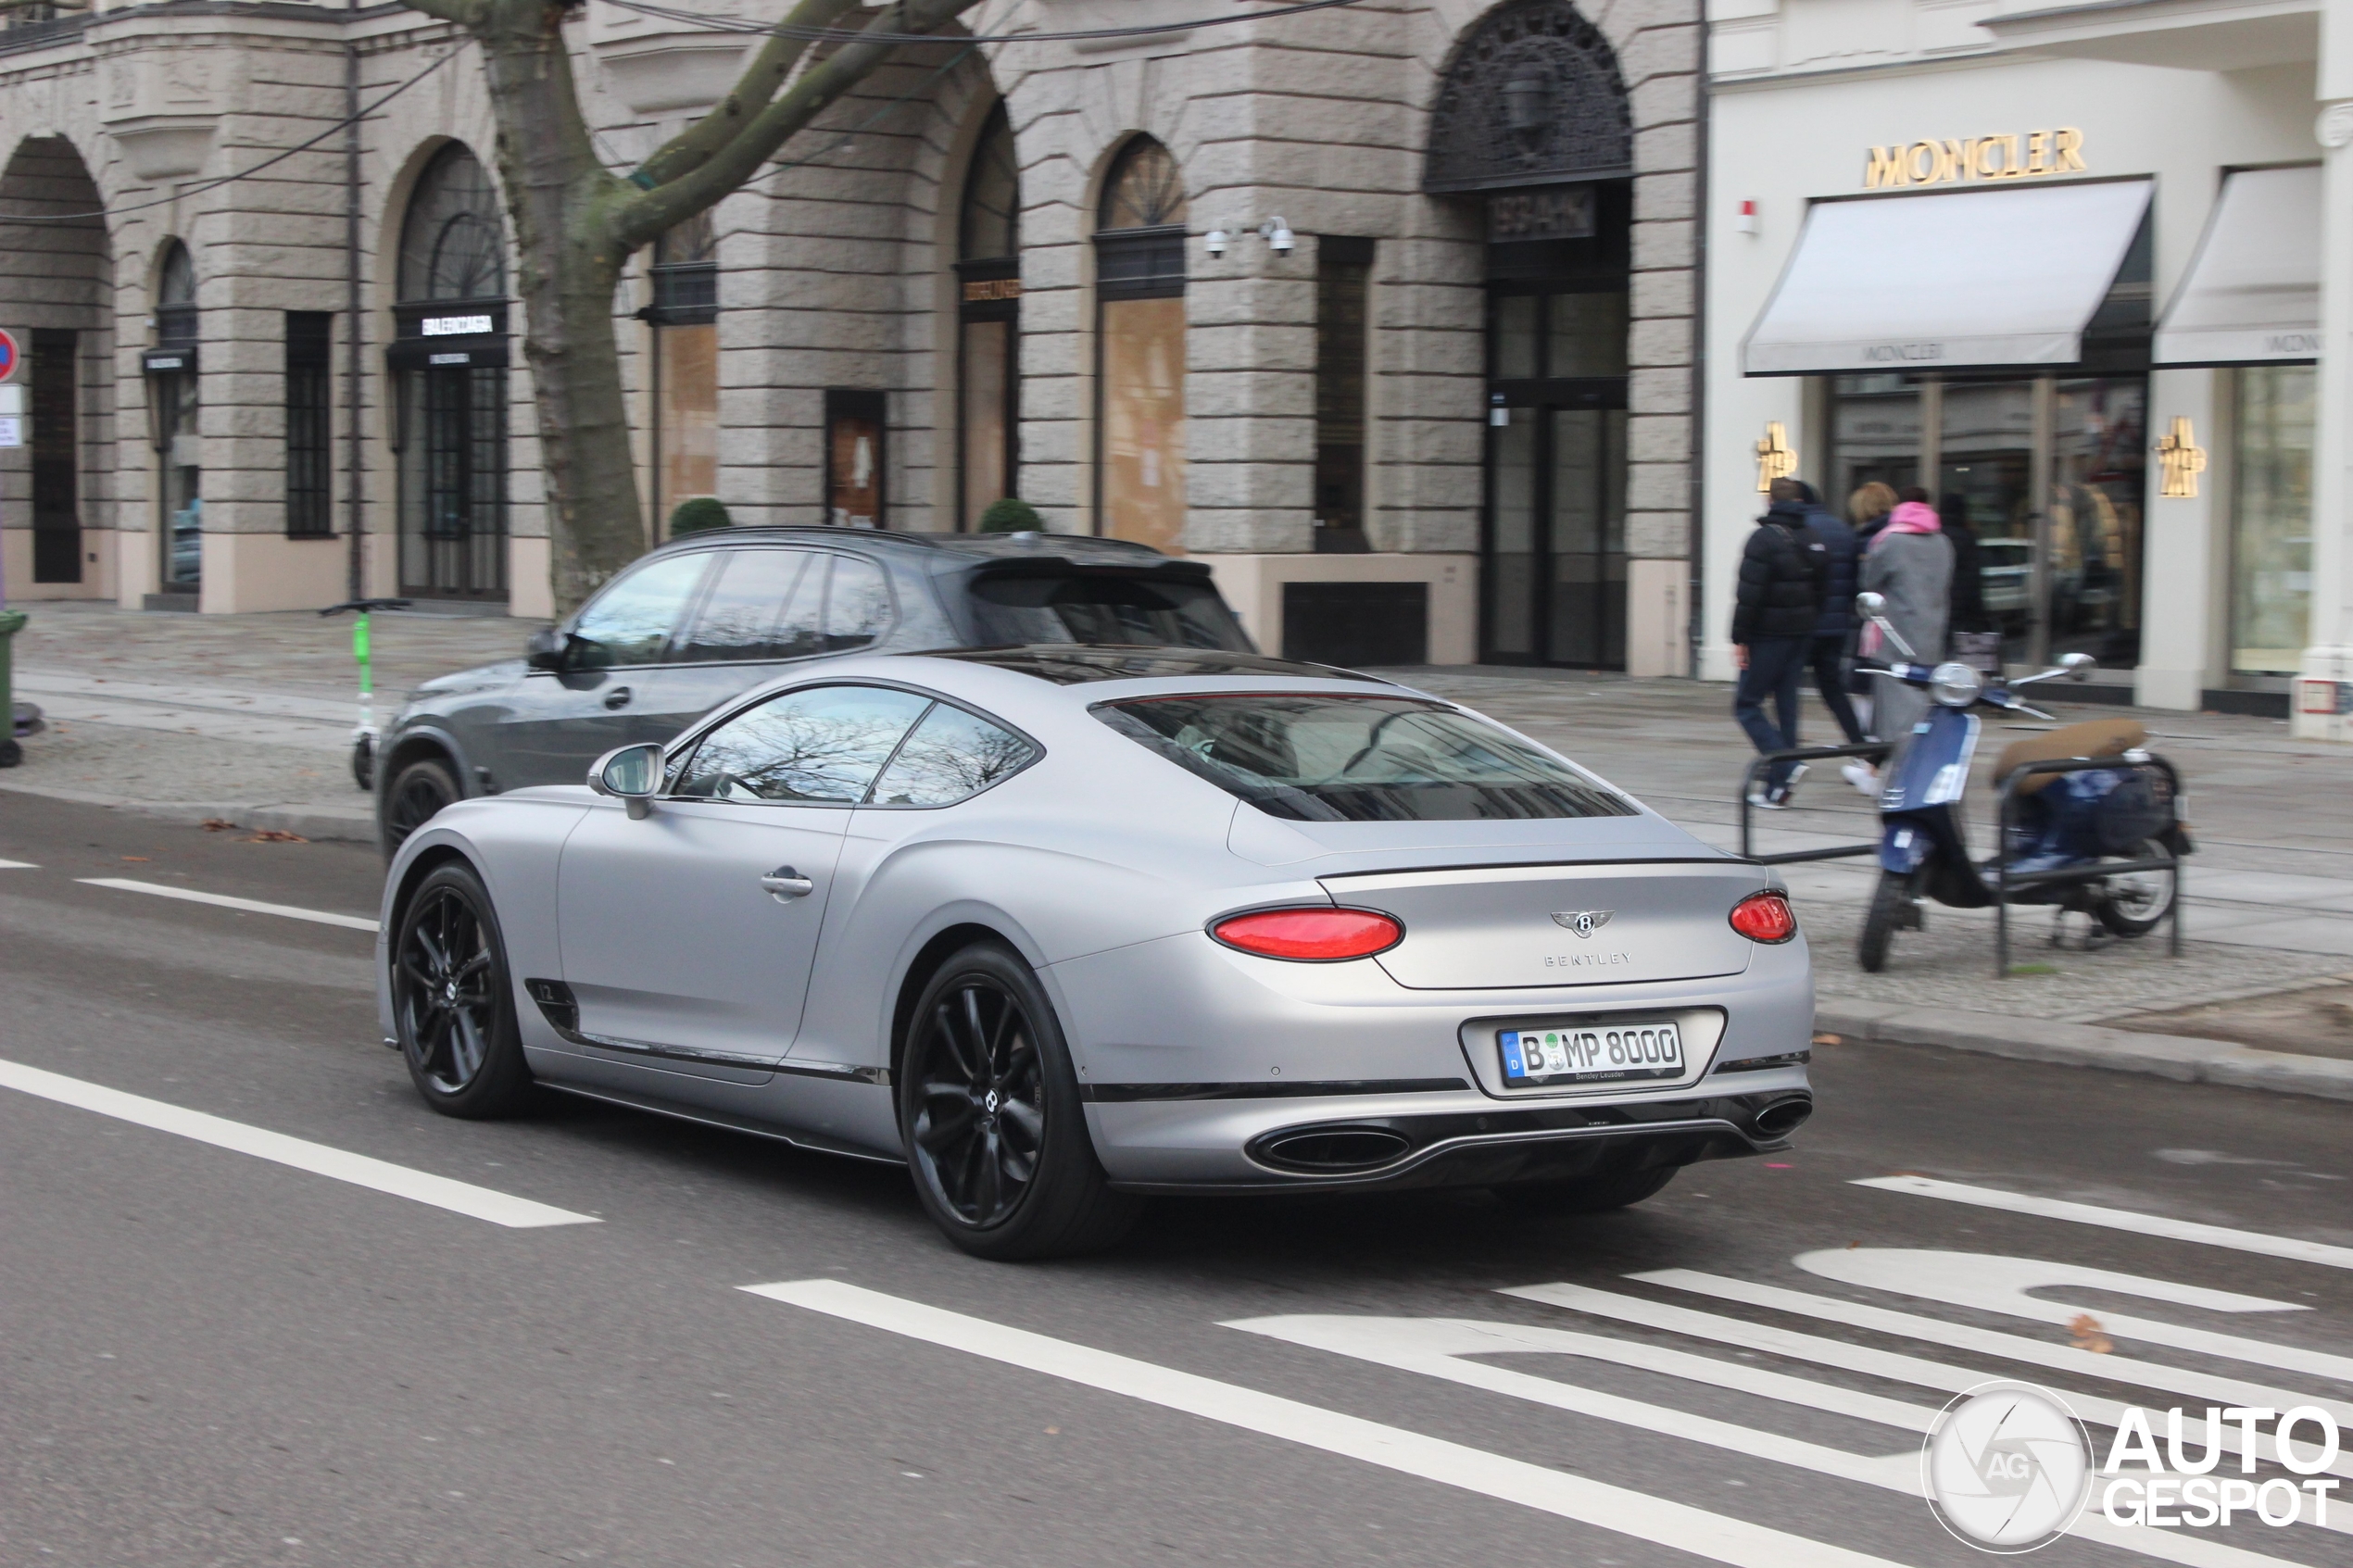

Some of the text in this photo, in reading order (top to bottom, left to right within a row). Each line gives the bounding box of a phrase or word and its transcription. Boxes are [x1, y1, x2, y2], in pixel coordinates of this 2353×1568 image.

[1863, 128, 2087, 188] MONCLER
[1544, 952, 1631, 967] BENTLEY
[1511, 1028, 1677, 1071] D B MP 8000
[1576, 1073, 1599, 1081] Bentley
